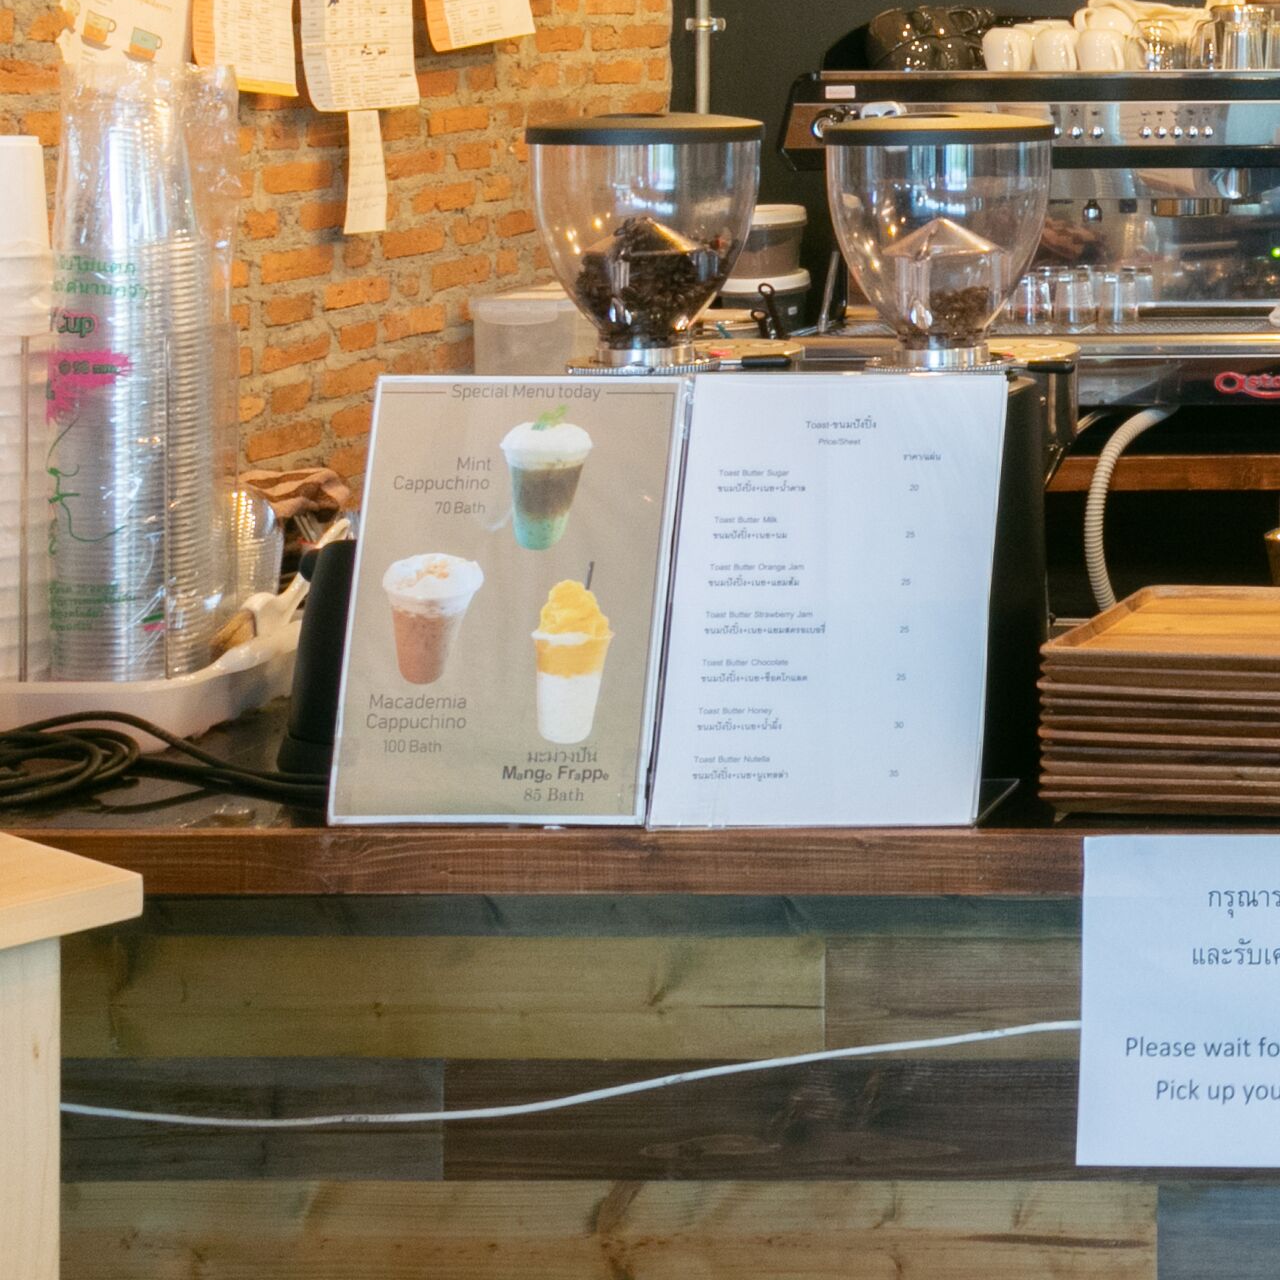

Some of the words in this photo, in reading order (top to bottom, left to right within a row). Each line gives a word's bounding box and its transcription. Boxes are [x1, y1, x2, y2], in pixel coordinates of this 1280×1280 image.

[451, 384, 509, 401] Special
[512, 385, 554, 399] Menu
[558, 384, 601, 401] today
[456, 456, 491, 471] Mint
[393, 475, 490, 492] Cappuchino
[435, 501, 451, 514] 70
[454, 500, 486, 514] Bath
[369, 694, 467, 710] Macademia
[366, 714, 466, 731] Cappuchino
[383, 740, 406, 753] 100
[409, 739, 442, 753] Bath
[502, 765, 552, 783] Mango
[557, 765, 609, 783] Frappe
[548, 787, 584, 801] Bath
[1125, 1037, 1196, 1058] Please
[1204, 1037, 1252, 1058] wait
[1155, 1080, 1199, 1101] Pick
[1207, 1084, 1235, 1105] up
